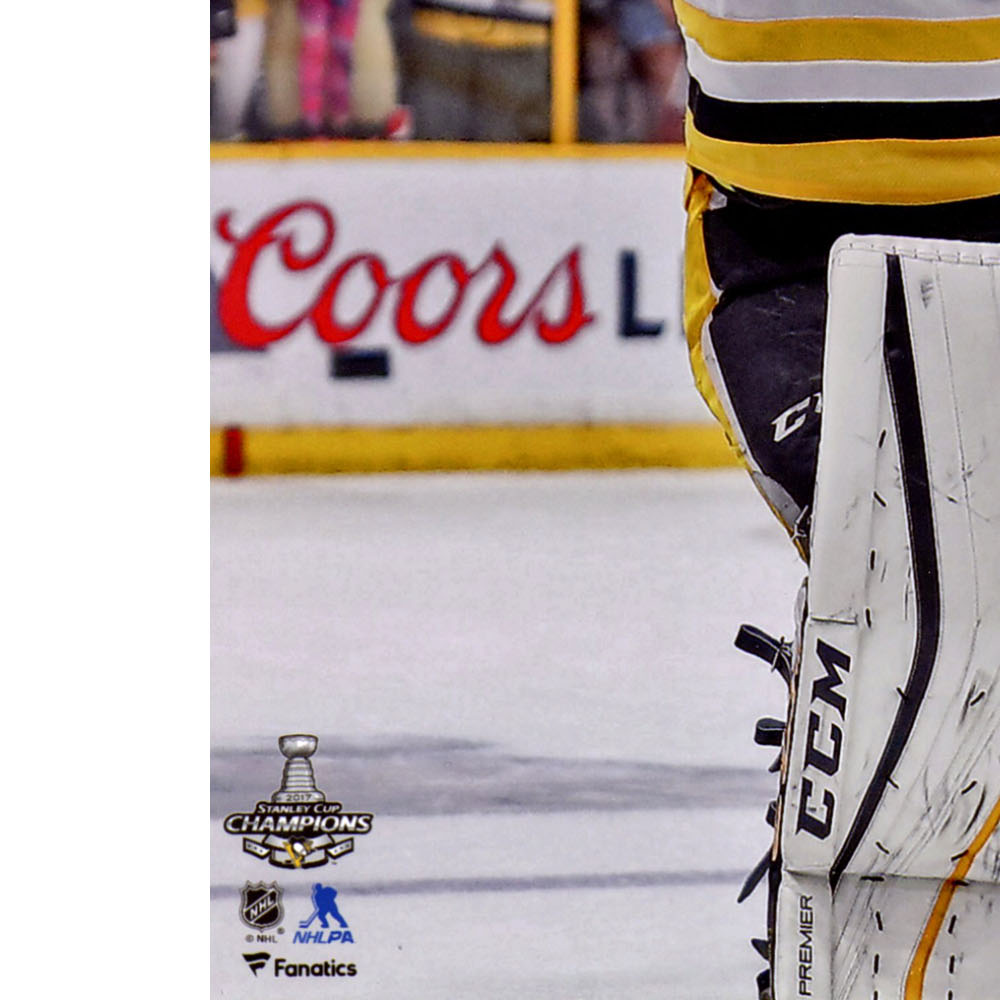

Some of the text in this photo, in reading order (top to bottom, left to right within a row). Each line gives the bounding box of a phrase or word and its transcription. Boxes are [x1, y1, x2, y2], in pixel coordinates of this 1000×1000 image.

[214, 200, 665, 348] Coors L
[795, 638, 850, 841] CCM
[799, 894, 813, 998] PREMIER
